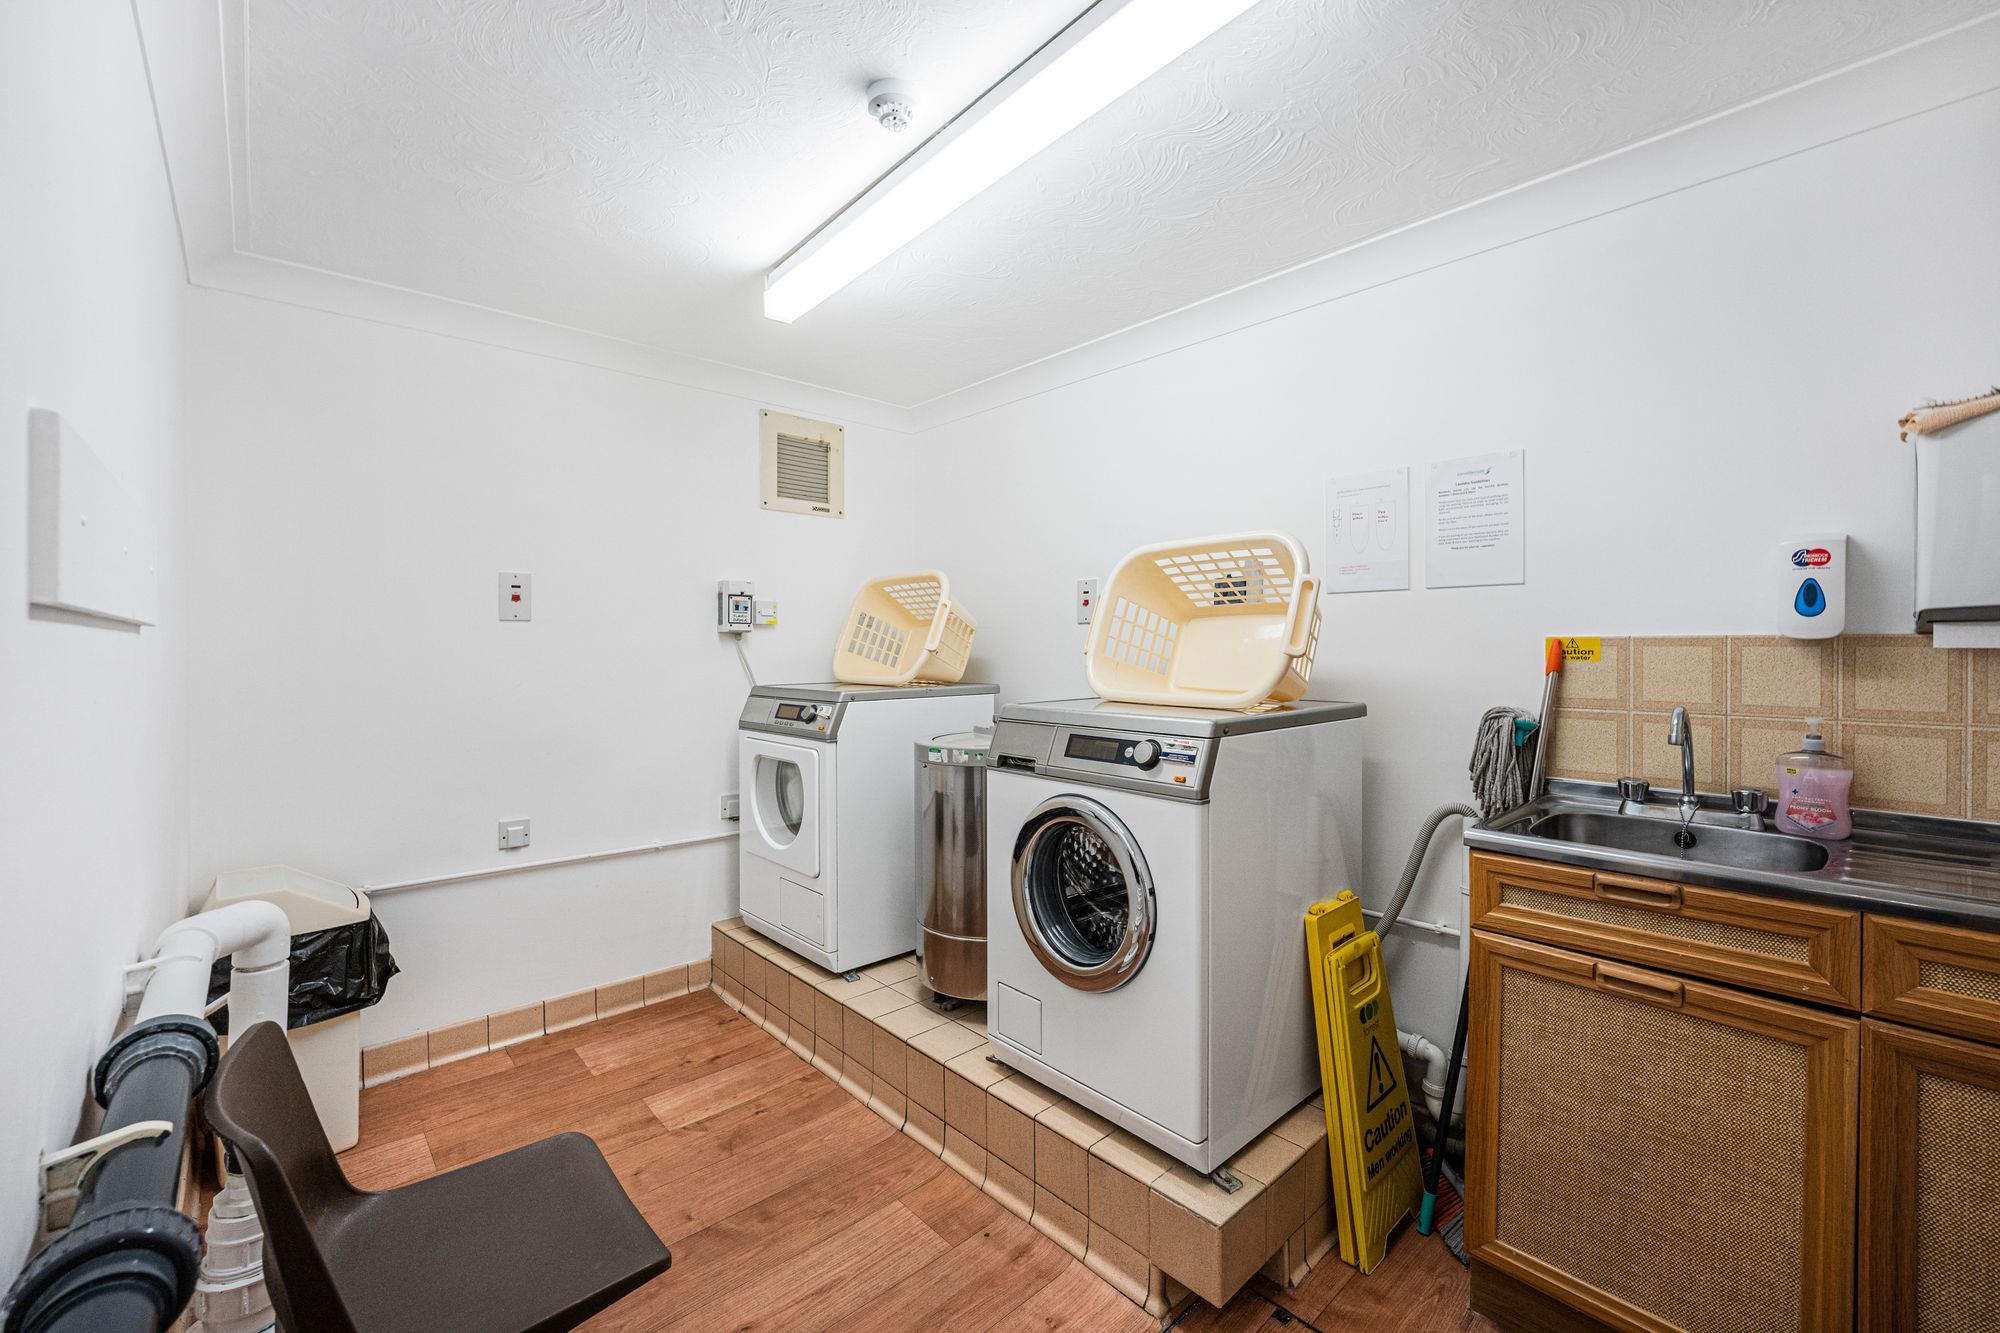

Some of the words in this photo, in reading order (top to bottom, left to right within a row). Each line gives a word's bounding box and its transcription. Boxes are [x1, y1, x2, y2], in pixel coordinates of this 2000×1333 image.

[1364, 1101, 1408, 1153] Caution
[1367, 1158, 1385, 1181] Men
[1385, 1127, 1413, 1162] working
